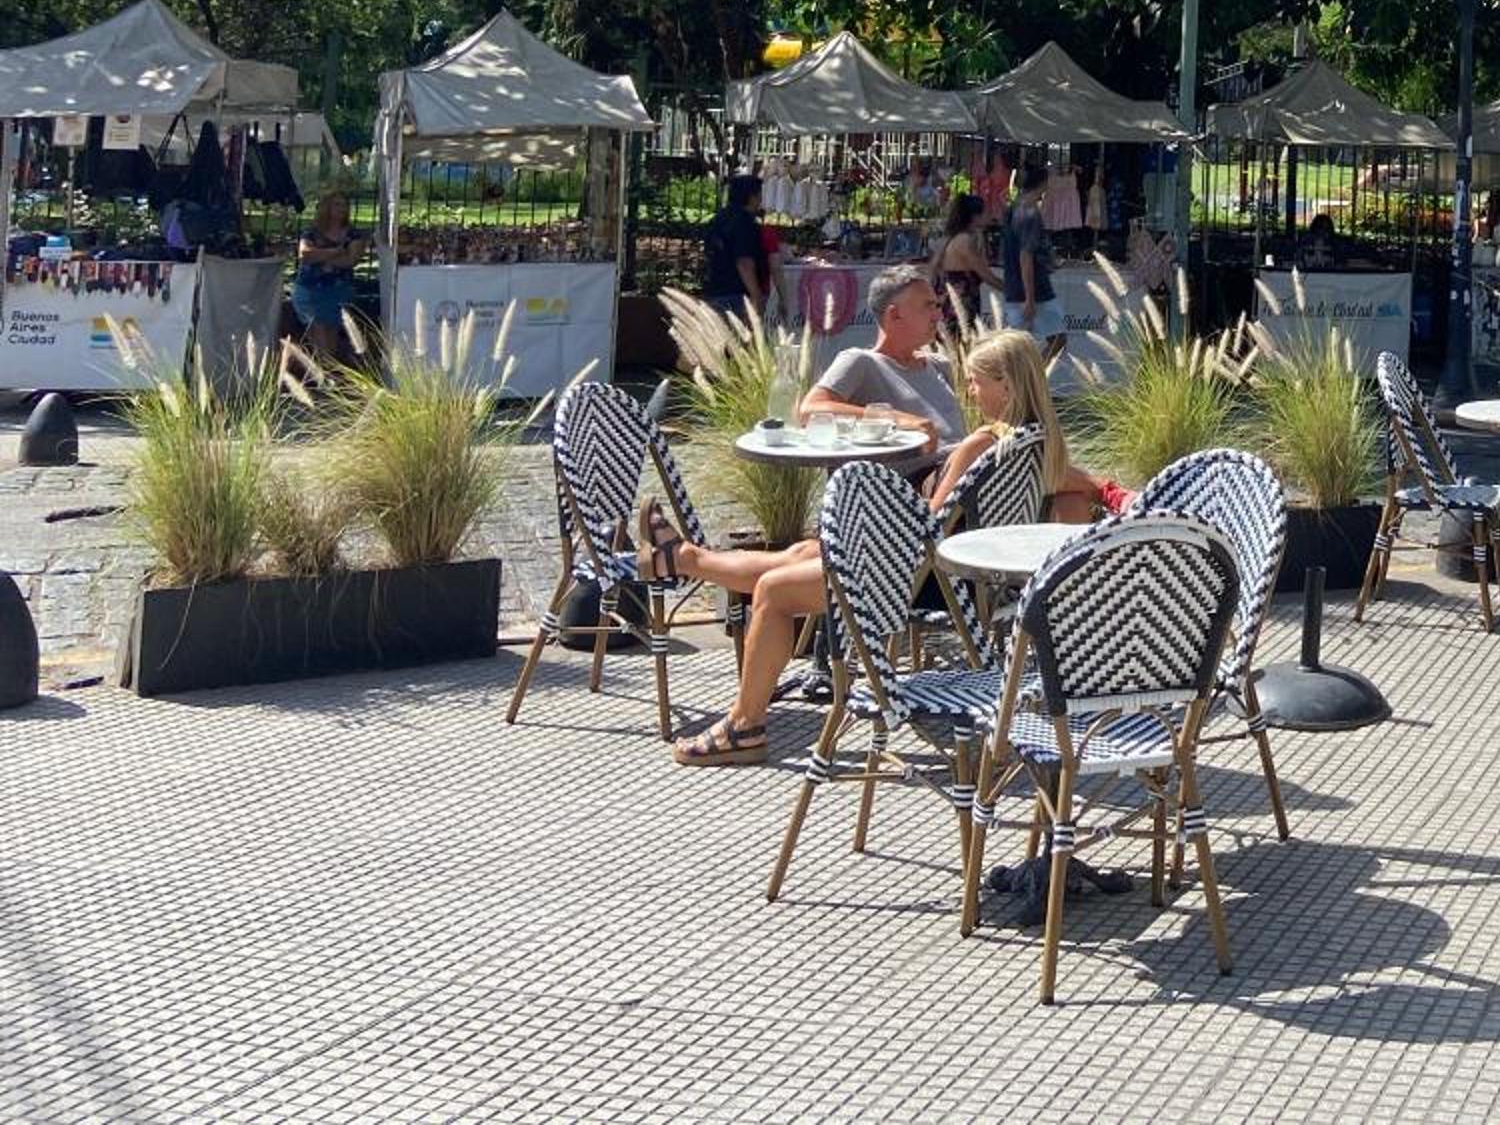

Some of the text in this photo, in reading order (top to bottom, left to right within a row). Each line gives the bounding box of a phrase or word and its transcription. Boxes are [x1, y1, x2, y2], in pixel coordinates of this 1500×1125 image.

[11, 310, 59, 322] Buenos
[10, 322, 47, 332] Aires
[8, 334, 57, 345] Ciudad
